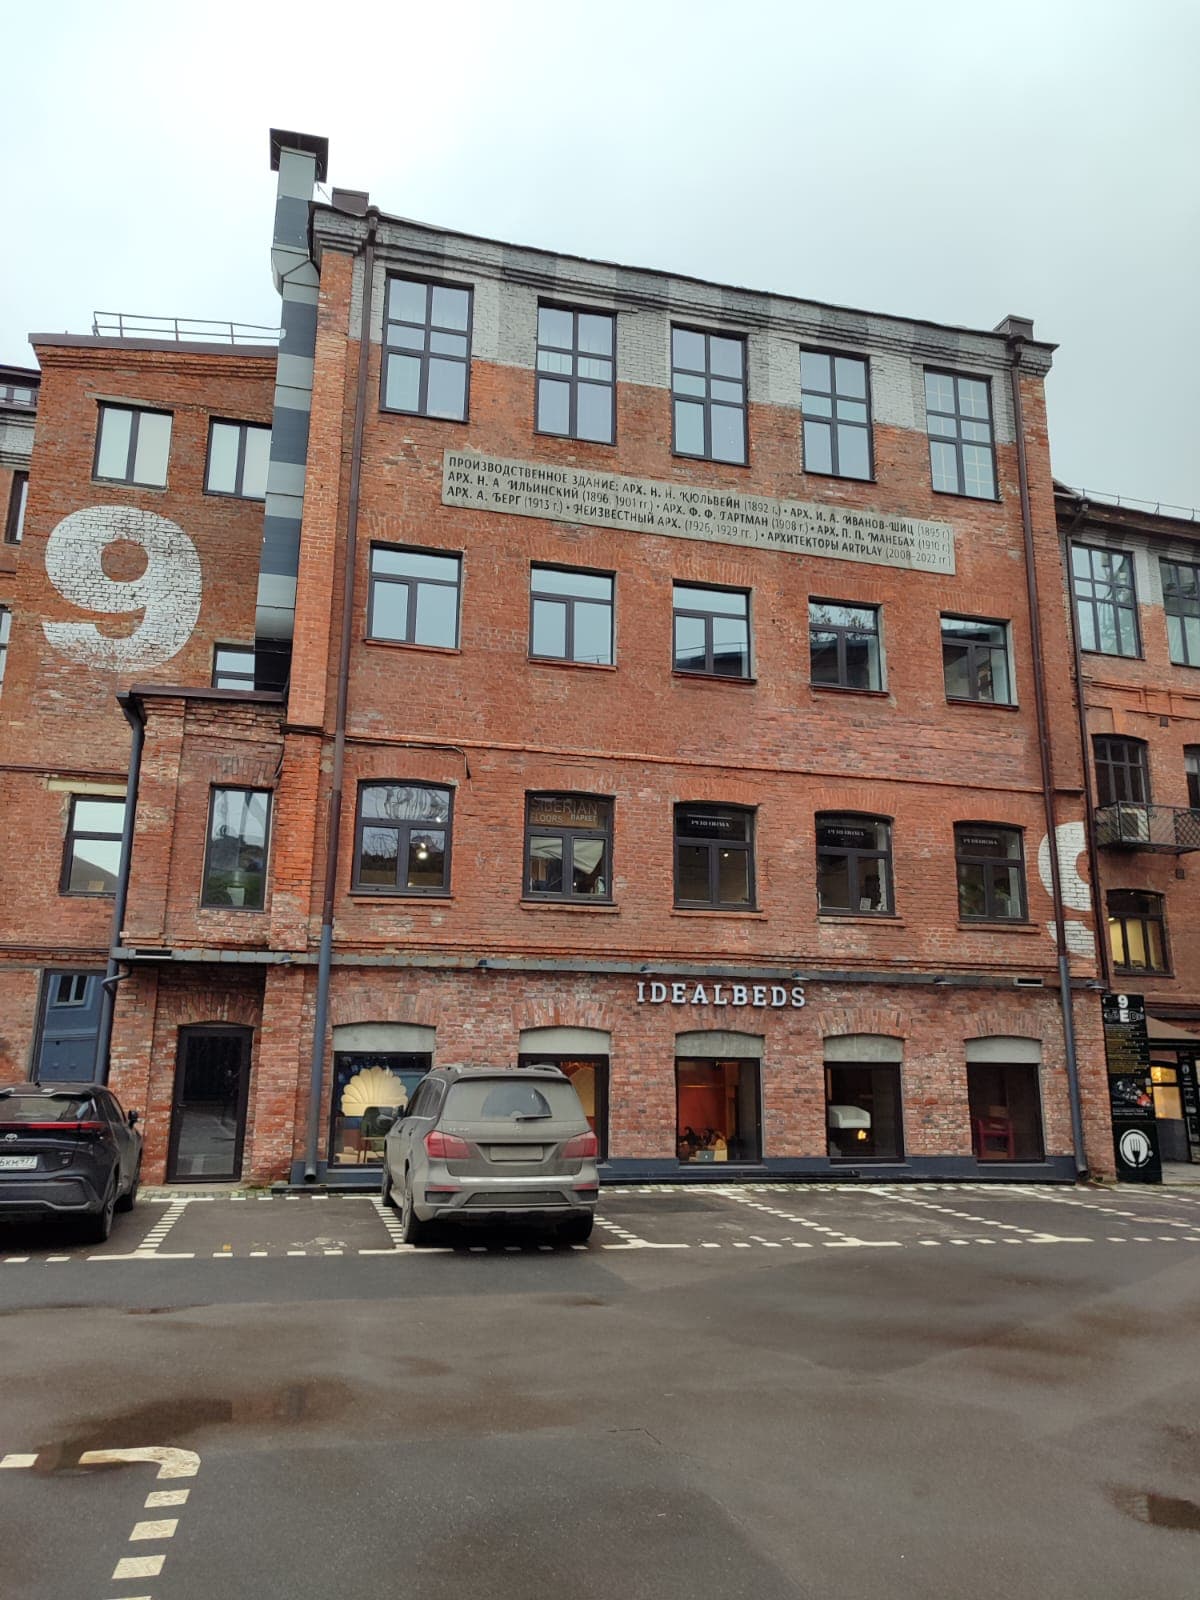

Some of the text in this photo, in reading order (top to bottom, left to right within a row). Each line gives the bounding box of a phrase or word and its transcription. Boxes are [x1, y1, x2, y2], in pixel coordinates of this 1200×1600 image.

[447, 485, 472, 499] АРХ.
[476, 490, 487, 501] А.
[492, 492, 521, 505] БЕРГ
[524, 496, 550, 510] (1913
[572, 503, 654, 525] НЕИЗВЕСТНЫЙ
[657, 516, 681, 528] АРХ.
[684, 519, 713, 535] (1926,
[717, 524, 738, 536] 1929
[767, 531, 839, 550] АРХИТЕКТОРЫ
[841, 542, 882, 557] ARTPLAY
[448, 471, 473, 484] АРХ.
[477, 475, 489, 487] Н.
[507, 480, 578, 499] ИЛЬИНСКИЙ
[615, 495, 636, 508] 1901
[662, 503, 686, 515] АРХ.
[689, 507, 701, 518] Ф.
[704, 509, 716, 520] Ф.
[720, 511, 768, 527] ГАРТМАН
[771, 517, 797, 531] (1908
[817, 525, 839, 537] АРХ.
[842, 528, 852, 539] П.
[855, 530, 865, 540] П.
[868, 532, 915, 547] МАНЕБАХ
[918, 539, 940, 554] (1910
[449, 457, 568, 484] ПРОИЗВОДСТВЕННОЕ
[572, 475, 618, 491] ЗДАНИЕ:
[622, 483, 647, 495] АРХ.
[651, 486, 661, 498] Н.
[665, 487, 676, 499] Н.
[680, 491, 740, 509] КЮЛЬВЕЙН
[744, 501, 769, 513] (1892
[791, 508, 813, 520] АРХ.
[816, 511, 826, 522] И.
[829, 513, 840, 523] А.
[843, 515, 914, 536] ИВАНОВ-ШИЦ
[917, 522, 940, 538] (1895
[42, 505, 202, 672] 9
[637, 982, 806, 1008] IDEALBEDS
[1117, 995, 1128, 1009] 9
